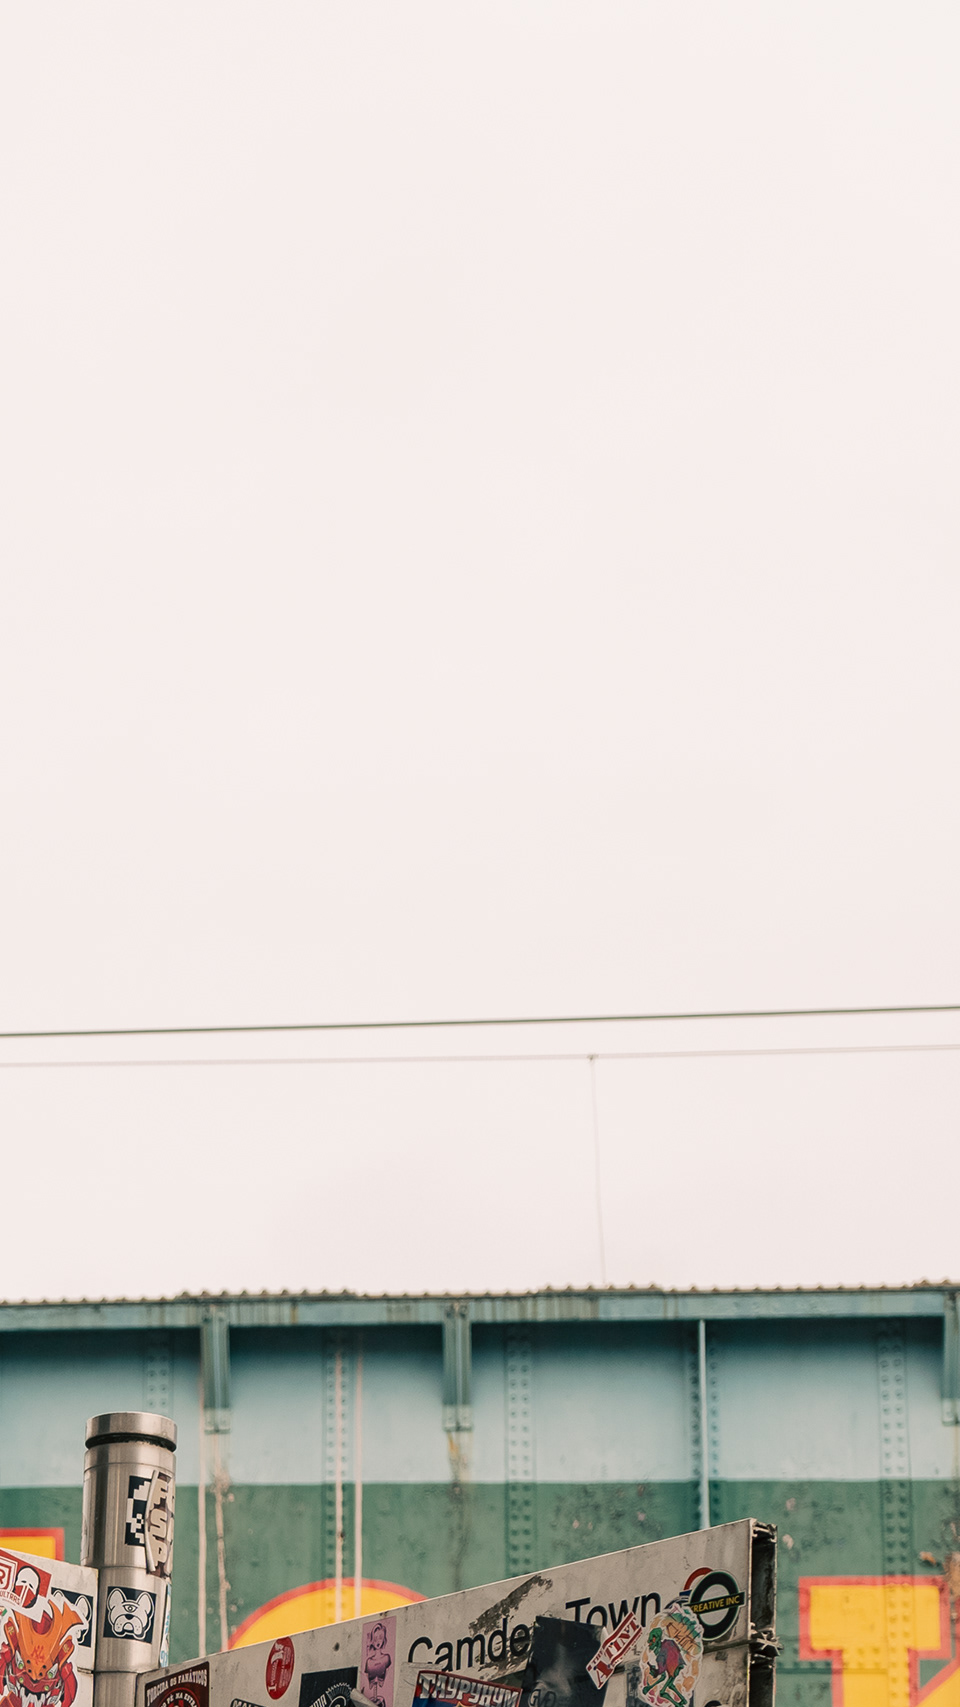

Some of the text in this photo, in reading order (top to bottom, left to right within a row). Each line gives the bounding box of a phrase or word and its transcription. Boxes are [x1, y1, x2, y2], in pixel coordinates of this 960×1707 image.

[0, 1588, 21, 1605] ULTRAS
[725, 1595, 740, 1606] INC
[407, 1591, 661, 1673] Camde Town
[146, 1681, 169, 1707] TORCIDA
[178, 1669, 208, 1688] FANÁTICOS
